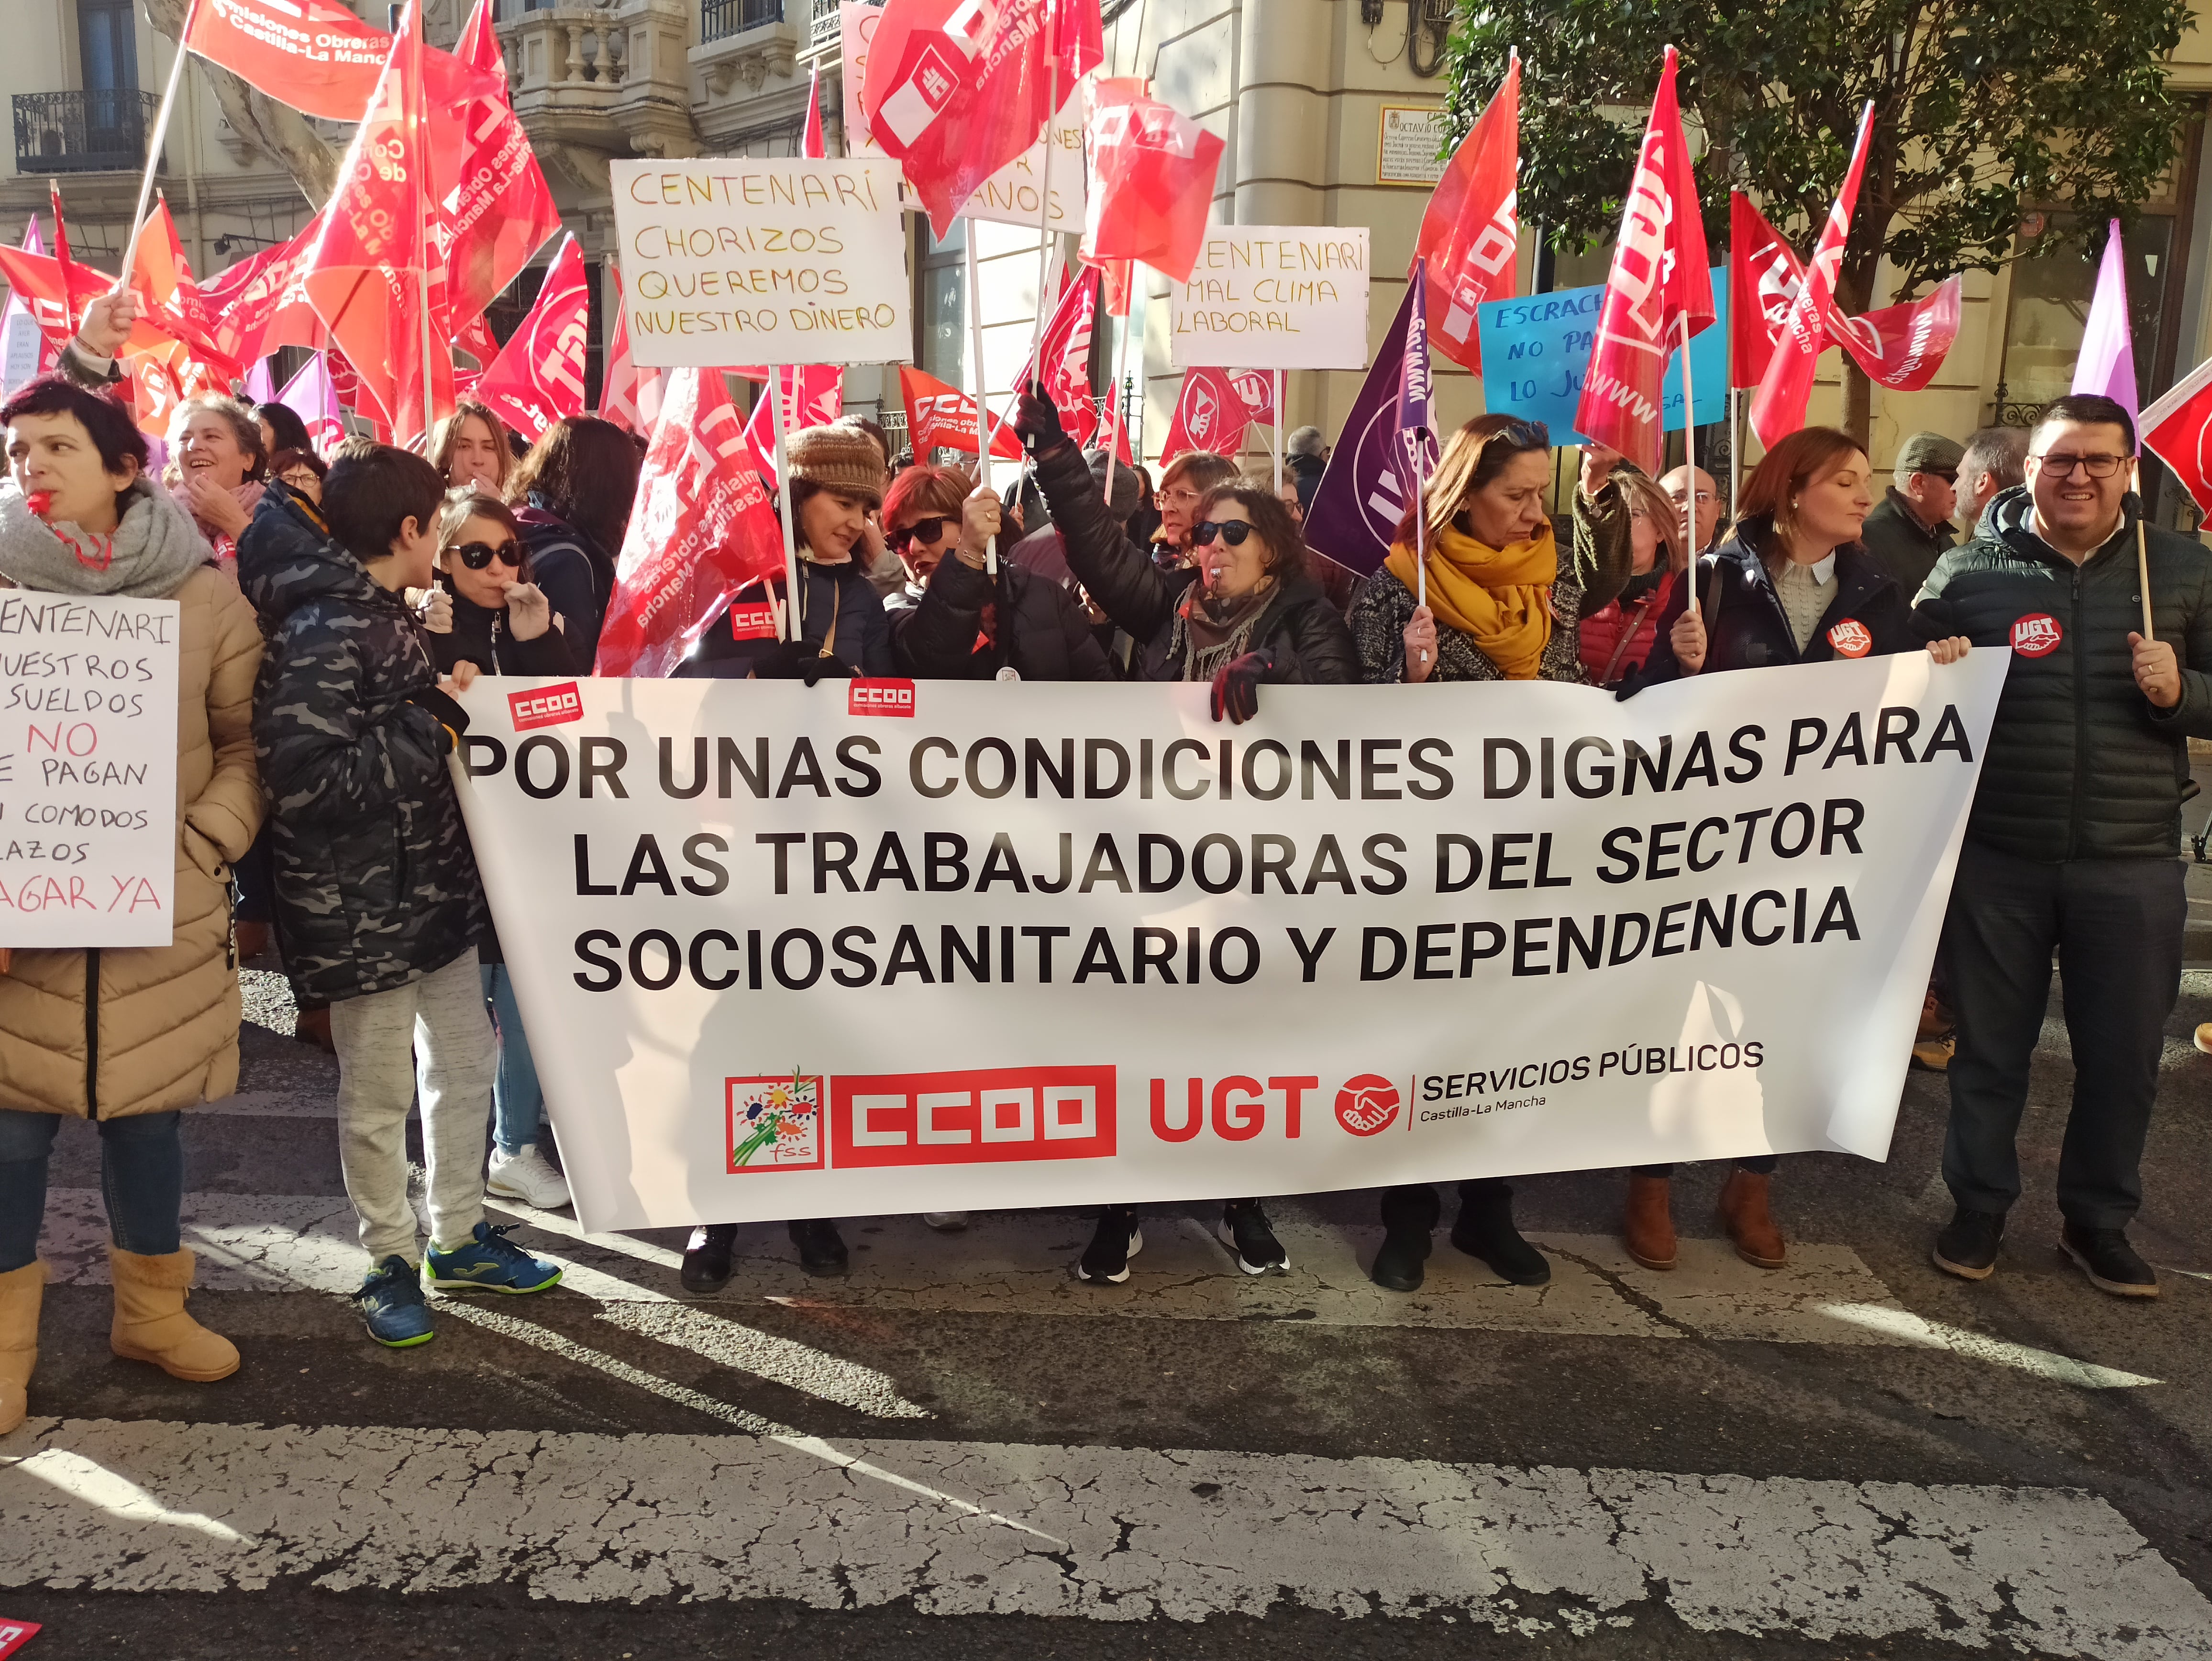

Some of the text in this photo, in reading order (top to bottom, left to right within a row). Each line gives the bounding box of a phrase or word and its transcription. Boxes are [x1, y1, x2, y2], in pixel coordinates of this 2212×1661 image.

[335, 49, 388, 66] Manc
[635, 225, 844, 259] CHORIZOS
[638, 268, 849, 299] QUEREMOS
[1187, 278, 1338, 306] MAL CLIMA
[635, 310, 778, 336] NUESTRO
[1177, 310, 1301, 333] LABORAL
[1508, 341, 1543, 360] NO
[1510, 379, 1537, 401] LO
[0, 598, 174, 645] ENTENARI
[1830, 620, 1864, 642] UGT
[2015, 618, 2053, 640] UGT
[4, 683, 144, 718] SUELDOS
[515, 692, 578, 717] CCOO
[853, 687, 912, 704] CCOO
[27, 722, 98, 757] NO
[463, 704, 1974, 800] POR UNAS CONDICIONES DIGNAS PARA
[42, 758, 148, 787] PAGAN
[25, 803, 148, 829] COMODOS
[574, 798, 1865, 897] LAS TRABAJADORAS DEL SECTOR
[108, 875, 161, 914] YA
[574, 885, 1861, 993] SOCIOSANITARIO Y DEPENDENCIA
[1422, 1041, 1764, 1102] SERVICIOS PÚBLICOS
[852, 1085, 1097, 1147] CCOO
[1149, 1074, 1319, 1143] UGT
[1420, 1094, 1547, 1123] Castilla-La Mancha
